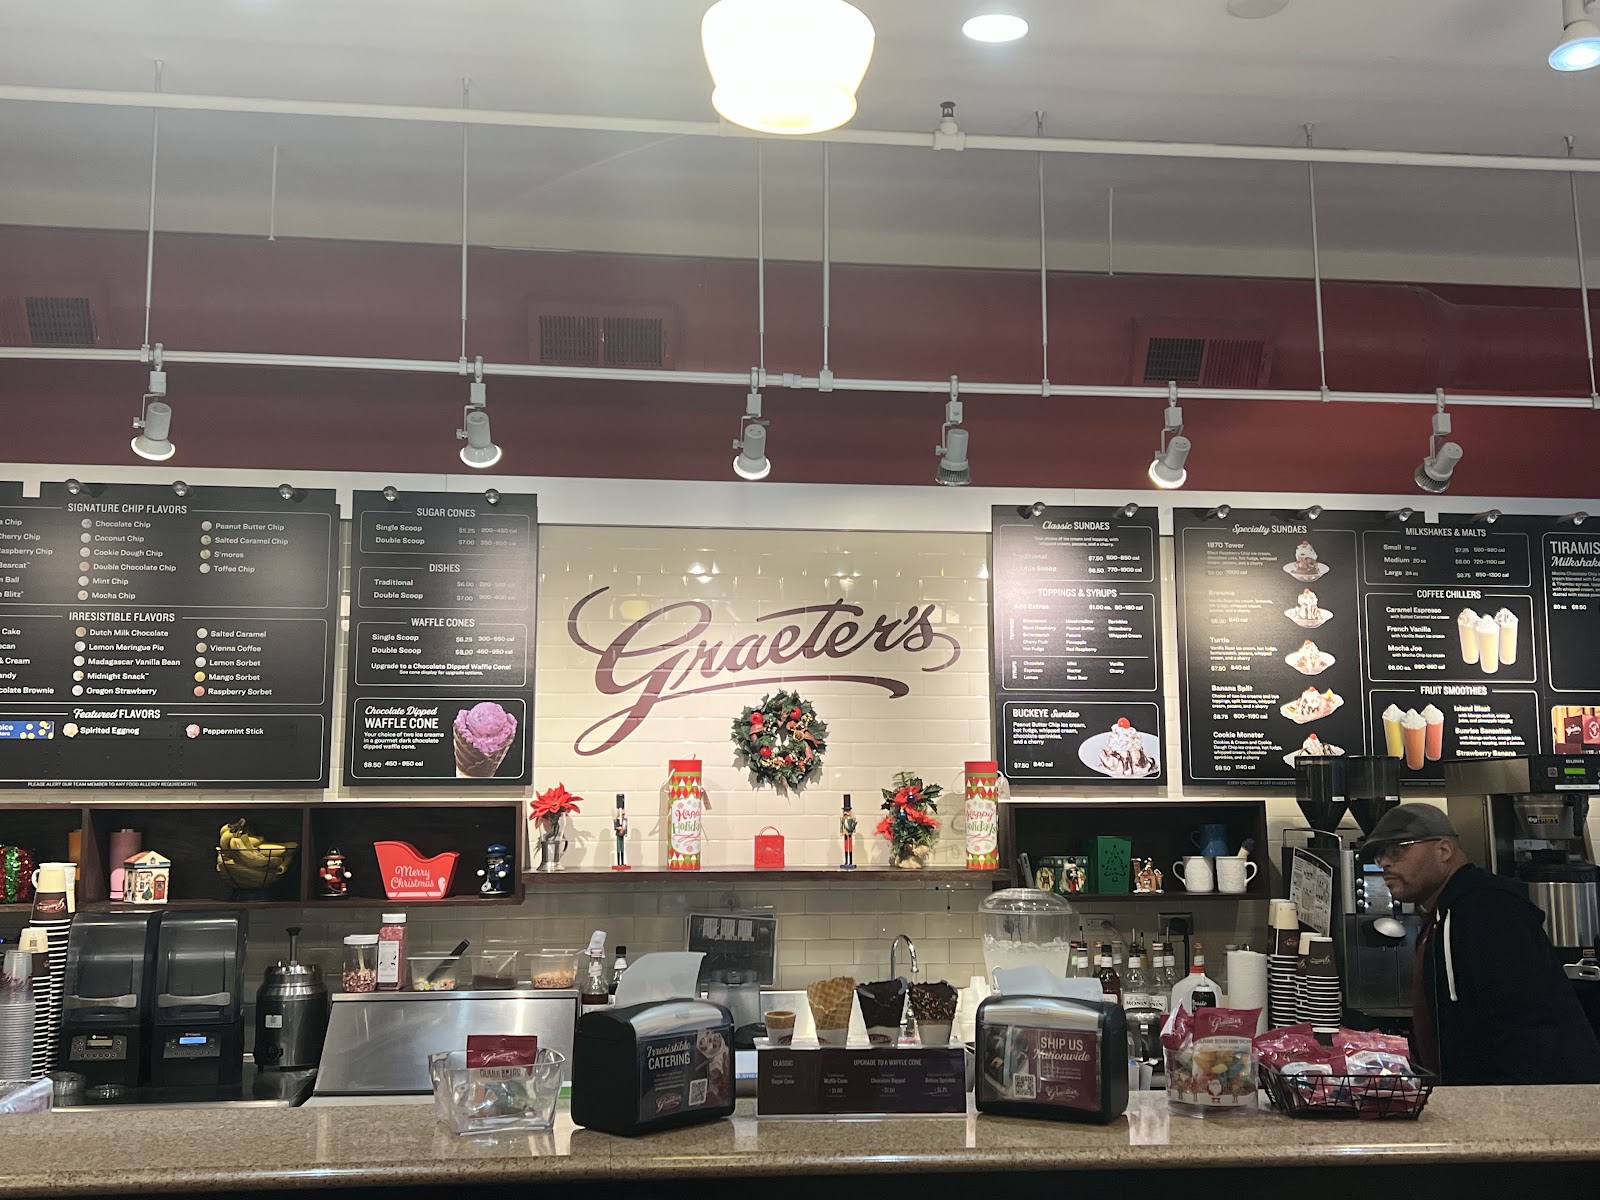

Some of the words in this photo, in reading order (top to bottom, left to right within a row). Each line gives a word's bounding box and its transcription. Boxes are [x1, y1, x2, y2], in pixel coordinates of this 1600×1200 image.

[68, 503, 119, 512] SIGNATURE
[122, 504, 144, 513] CHIP
[147, 505, 186, 514] FLAVORS
[417, 508, 445, 517] SUGAR
[447, 509, 475, 517] CONES
[376, 524, 398, 532] Single
[1043, 520, 1073, 530] Classic
[1074, 522, 1110, 530] SUNDAES
[1232, 524, 1270, 535] Specialty
[1406, 528, 1452, 536] MILKSHAKES
[1462, 529, 1486, 537] MALTS
[429, 564, 460, 572] DISHES
[401, 592, 423, 600] Scoop
[1038, 589, 1076, 597] TOPPINGS
[1078, 589, 1085, 597] &
[1086, 589, 1117, 597] SYRUPS
[1446, 591, 1481, 599] CHILLERS
[69, 612, 131, 621] IRRESISTIBLE
[134, 613, 175, 622] FLAVORS
[411, 618, 444, 627] WAFFLE
[446, 619, 475, 627] CONES
[399, 647, 421, 655] Scoop
[88, 658, 133, 666] Madagascar
[567, 586, 960, 756] Graeter's
[88, 673, 120, 681] Midnight
[115, 688, 157, 696] Strawberry
[208, 688, 246, 696] Raspberry
[1421, 686, 1442, 694] FRUIT
[1444, 687, 1487, 695] SMOOTHIES
[73, 709, 118, 719] Featured
[119, 709, 161, 718] FLAVORS
[365, 706, 405, 715] Chocolate
[406, 707, 438, 716] Dipped
[1013, 709, 1048, 717] BUCKEYE
[1051, 710, 1079, 718] Sundae
[365, 718, 408, 728] WAFFLE
[410, 718, 438, 729] CONE
[203, 728, 244, 736] Peppermint
[395, 865, 430, 880] Merry
[391, 877, 434, 889] Christmas
[1040, 1037, 1067, 1049] SHIP
[1069, 1040, 1083, 1051] US
[647, 1040, 691, 1058] Irresistible
[1033, 1048, 1091, 1061] Nationwide
[648, 1053, 691, 1071] CATERING
